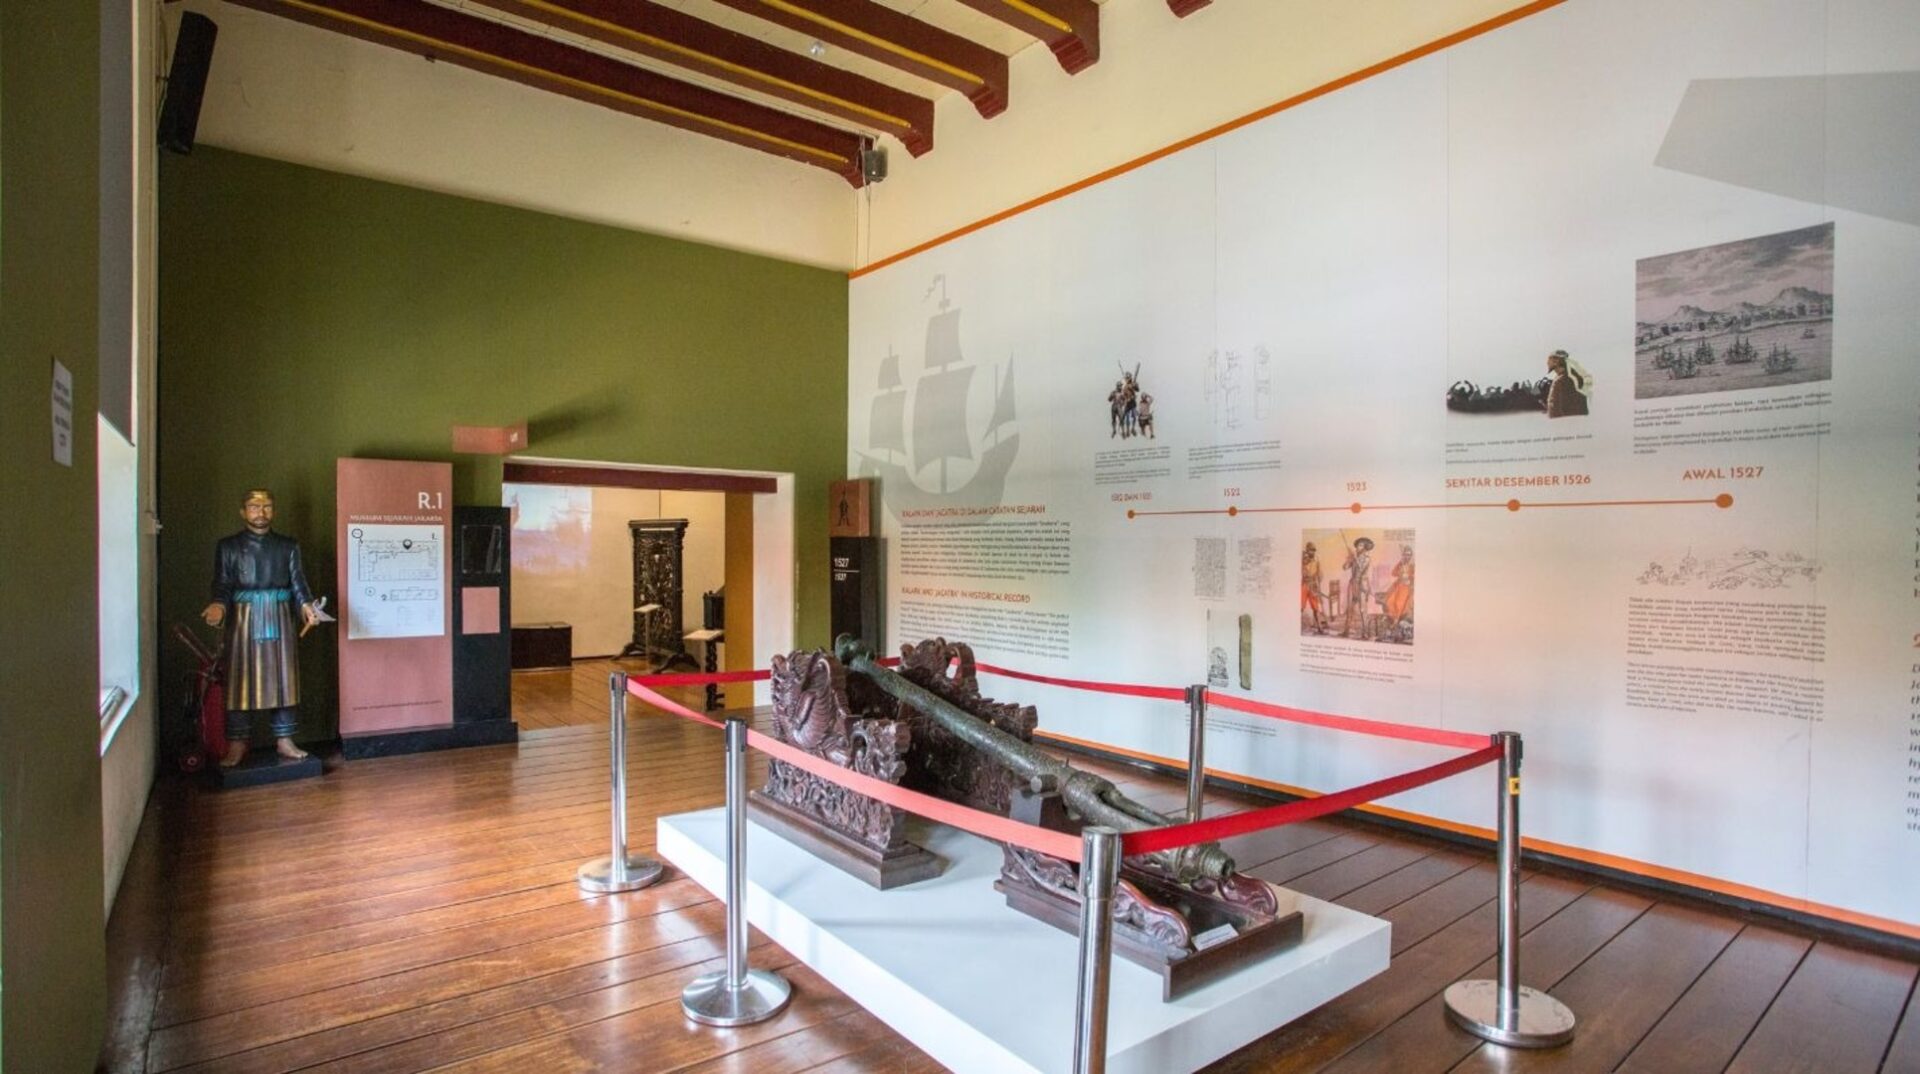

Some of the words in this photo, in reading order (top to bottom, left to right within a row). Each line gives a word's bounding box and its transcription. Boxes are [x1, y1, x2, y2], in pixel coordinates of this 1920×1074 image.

[1445, 476, 1491, 489] SEKITAR
[1494, 474, 1560, 488] DESEMBER
[1563, 473, 1592, 486] 1526
[1683, 467, 1725, 481] AWAL
[1729, 465, 1765, 479] 1527
[417, 491, 443, 510] R.1
